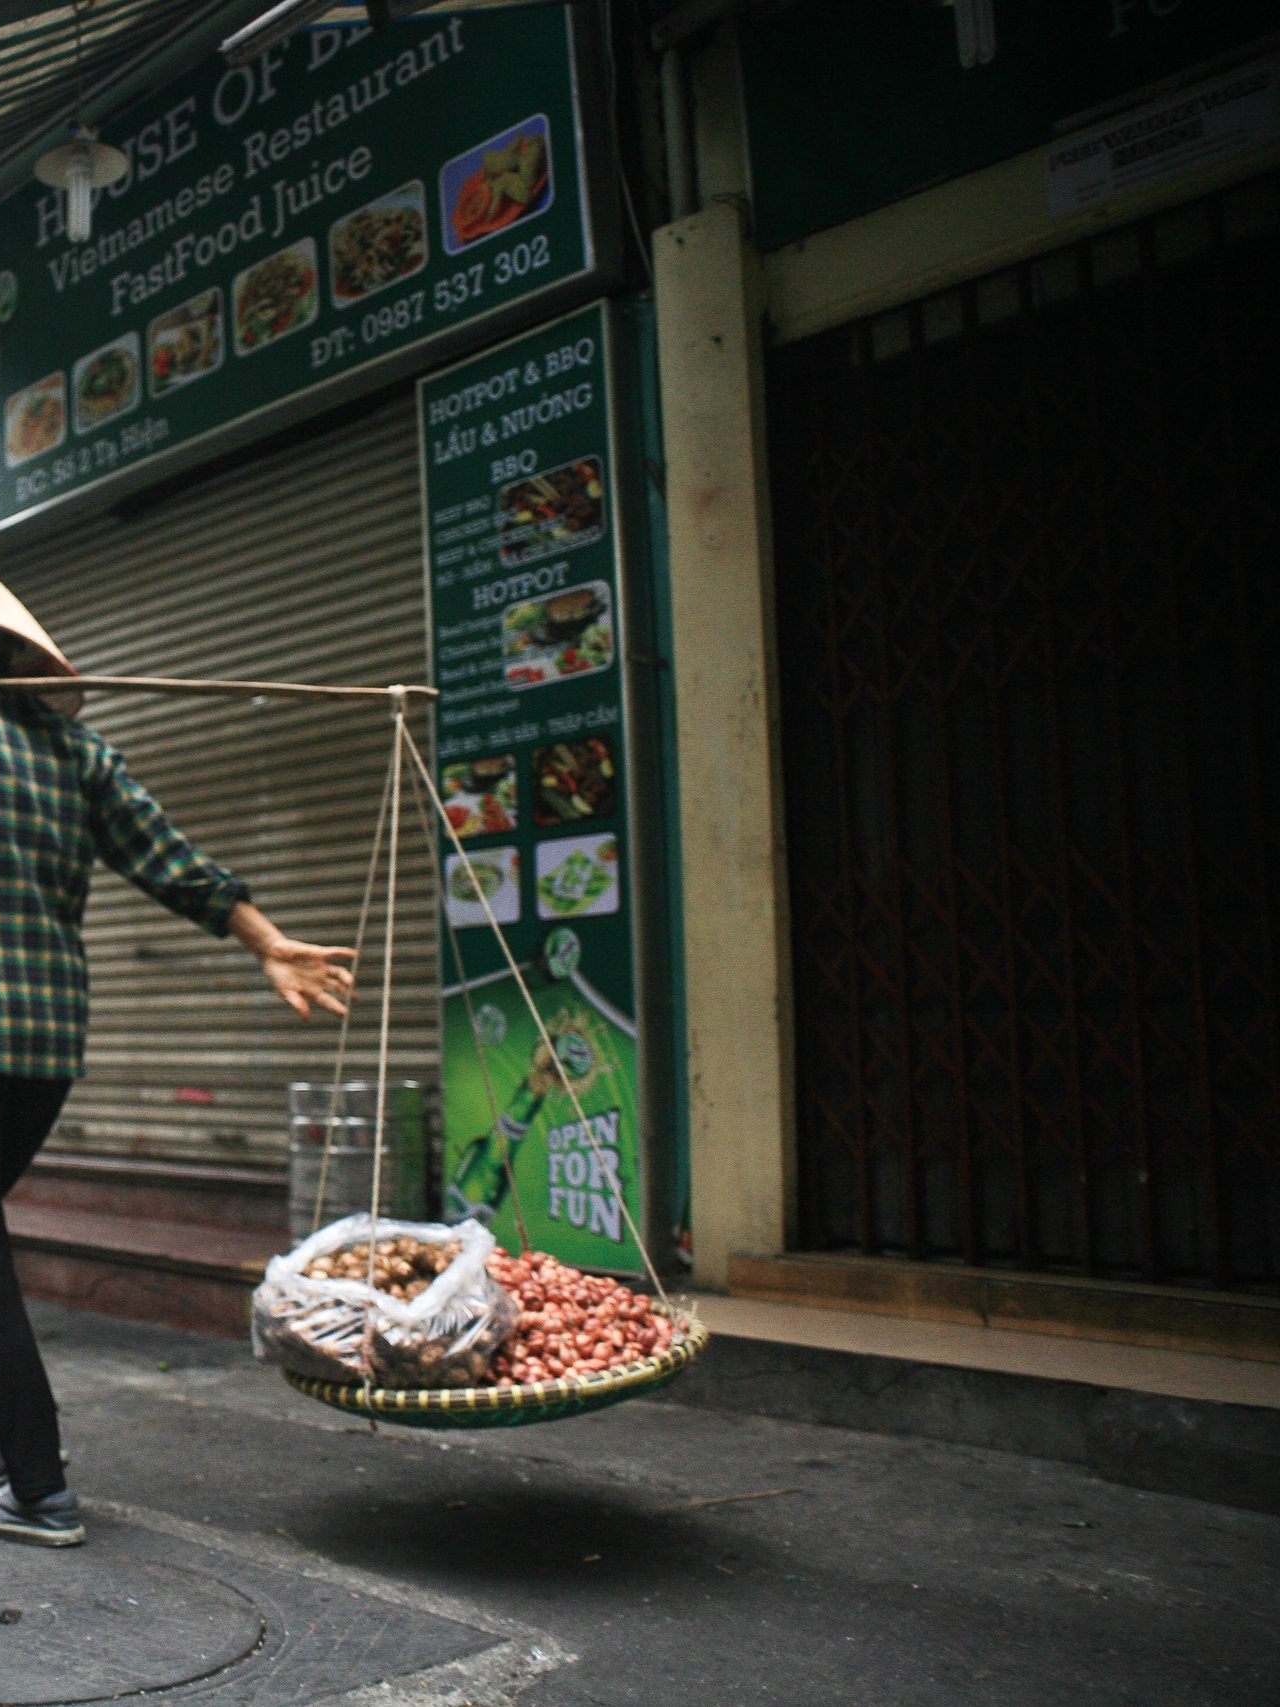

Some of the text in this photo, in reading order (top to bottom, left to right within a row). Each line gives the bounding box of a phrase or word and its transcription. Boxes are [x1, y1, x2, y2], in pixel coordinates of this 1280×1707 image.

[36, 97, 198, 247] HUSE
[213, 37, 290, 125] OF
[49, 17, 465, 291] Vietnamese Restaurant
[110, 147, 372, 316] FastFood Juice
[361, 290, 425, 343] 0987
[433, 263, 485, 312] 537
[494, 235, 550, 284] 302
[429, 337, 595, 425] HOTPOT & BBQ
[480, 421, 498, 446] &
[78, 447, 91, 473] 2
[491, 450, 537, 483] BBQ
[472, 561, 570, 610] HOTPOT
[548, 1111, 619, 1151] OPEN
[548, 1147, 622, 1191] FOR
[548, 1186, 623, 1242] FUN
